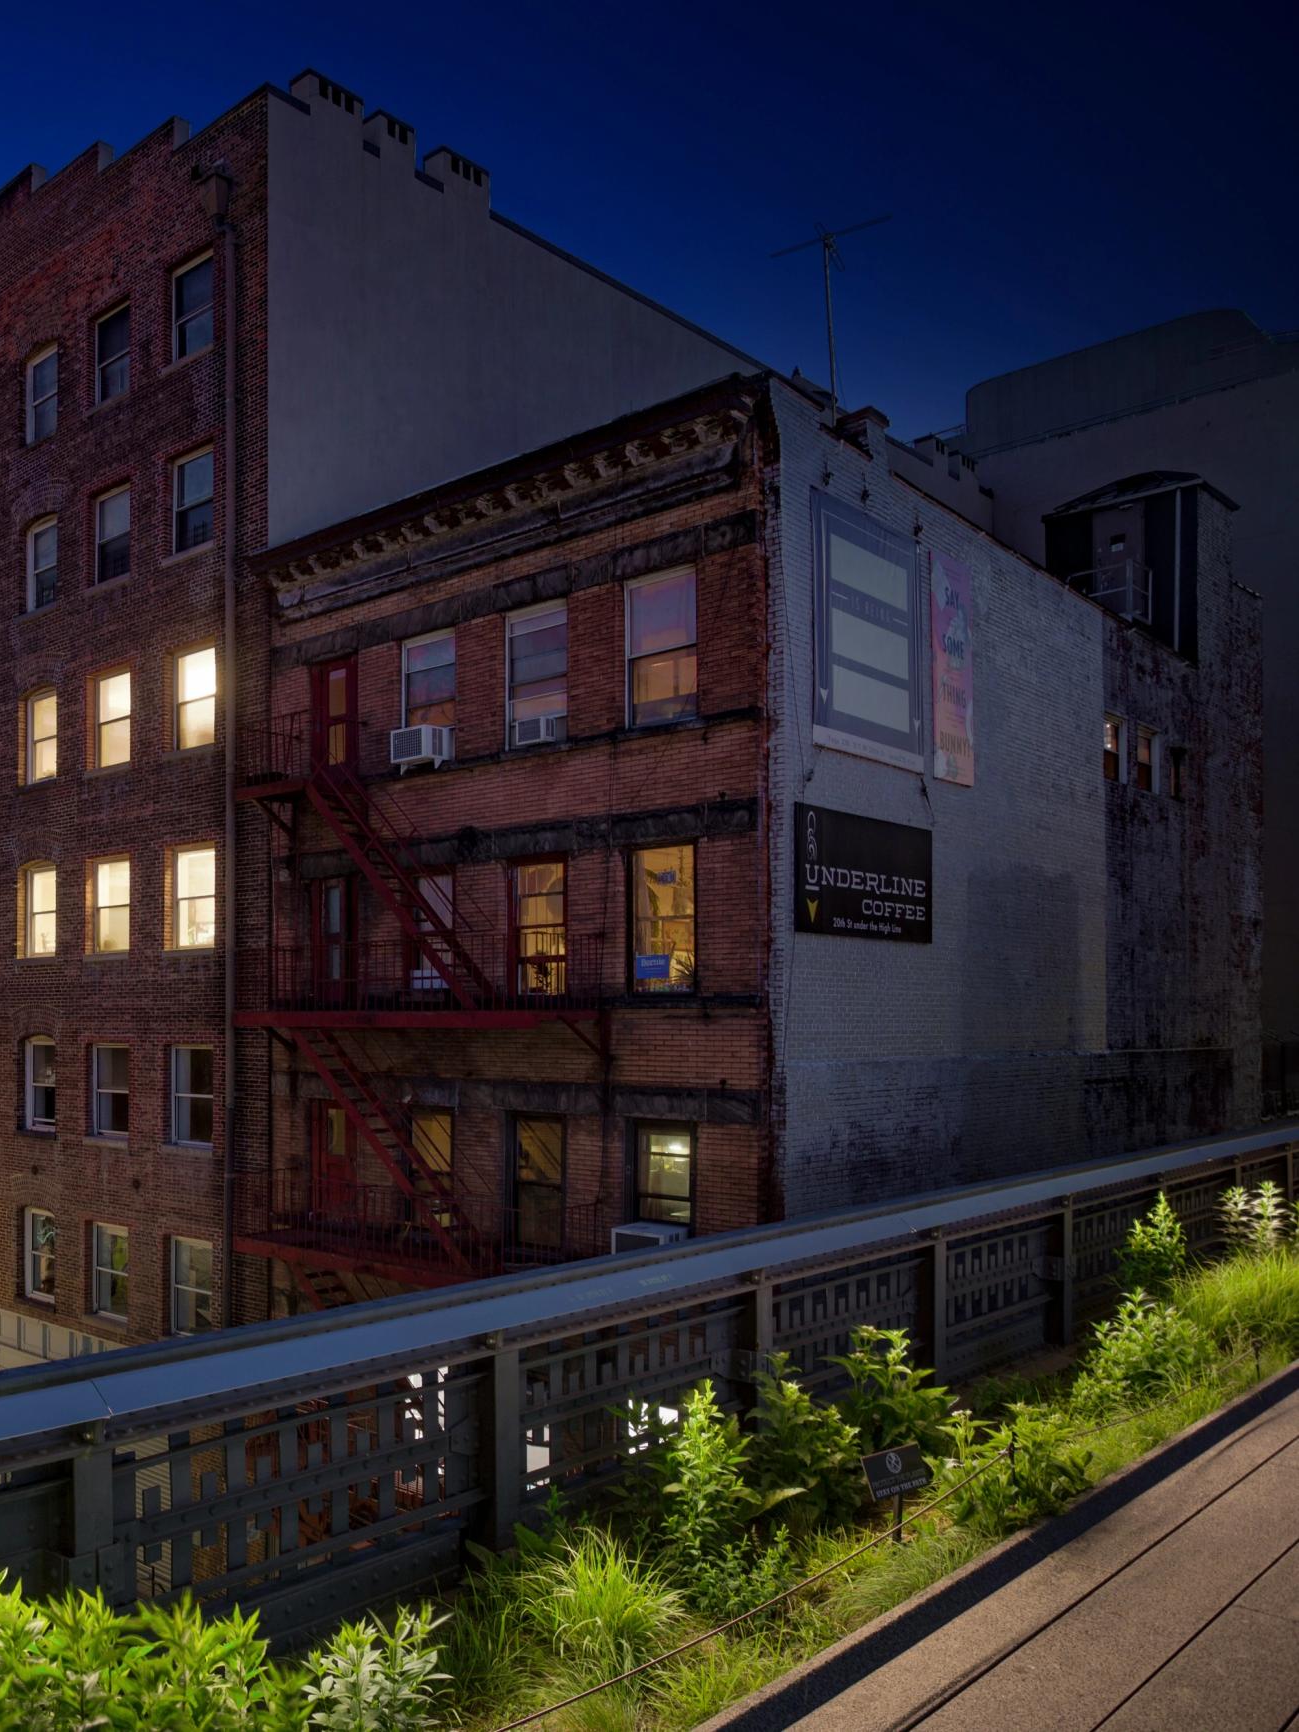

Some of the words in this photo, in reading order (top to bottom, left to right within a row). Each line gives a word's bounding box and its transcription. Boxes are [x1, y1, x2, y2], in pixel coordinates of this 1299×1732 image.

[945, 586, 959, 608] SAY
[942, 633, 964, 660] SOME
[941, 682, 966, 708] THING
[805, 864, 926, 898] UNDERLINE
[862, 899, 926, 921] COFFEE
